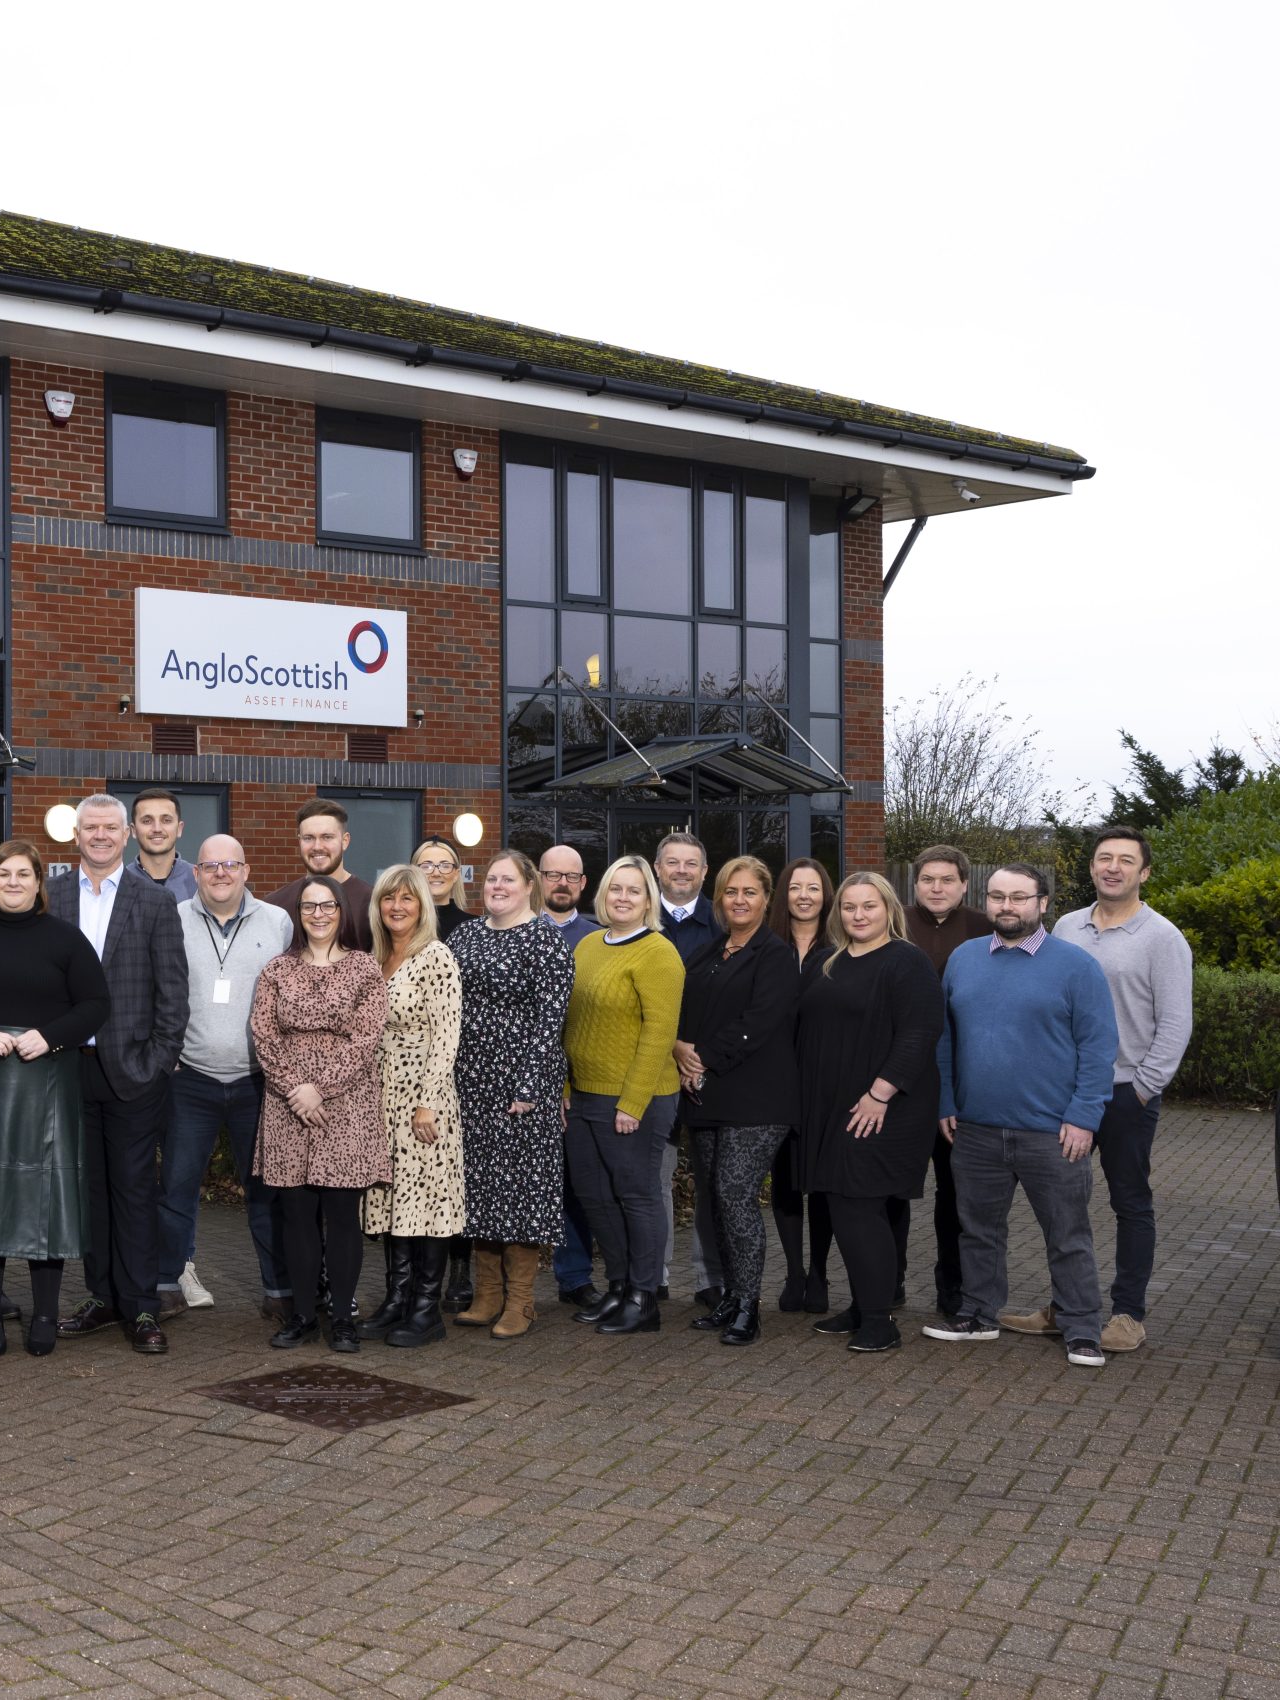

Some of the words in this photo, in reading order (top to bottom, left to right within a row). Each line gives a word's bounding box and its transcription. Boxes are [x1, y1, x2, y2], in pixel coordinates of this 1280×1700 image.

[160, 649, 348, 691] AngloScottish
[244, 695, 287, 706] ASSET
[292, 697, 349, 711] FINANCE
